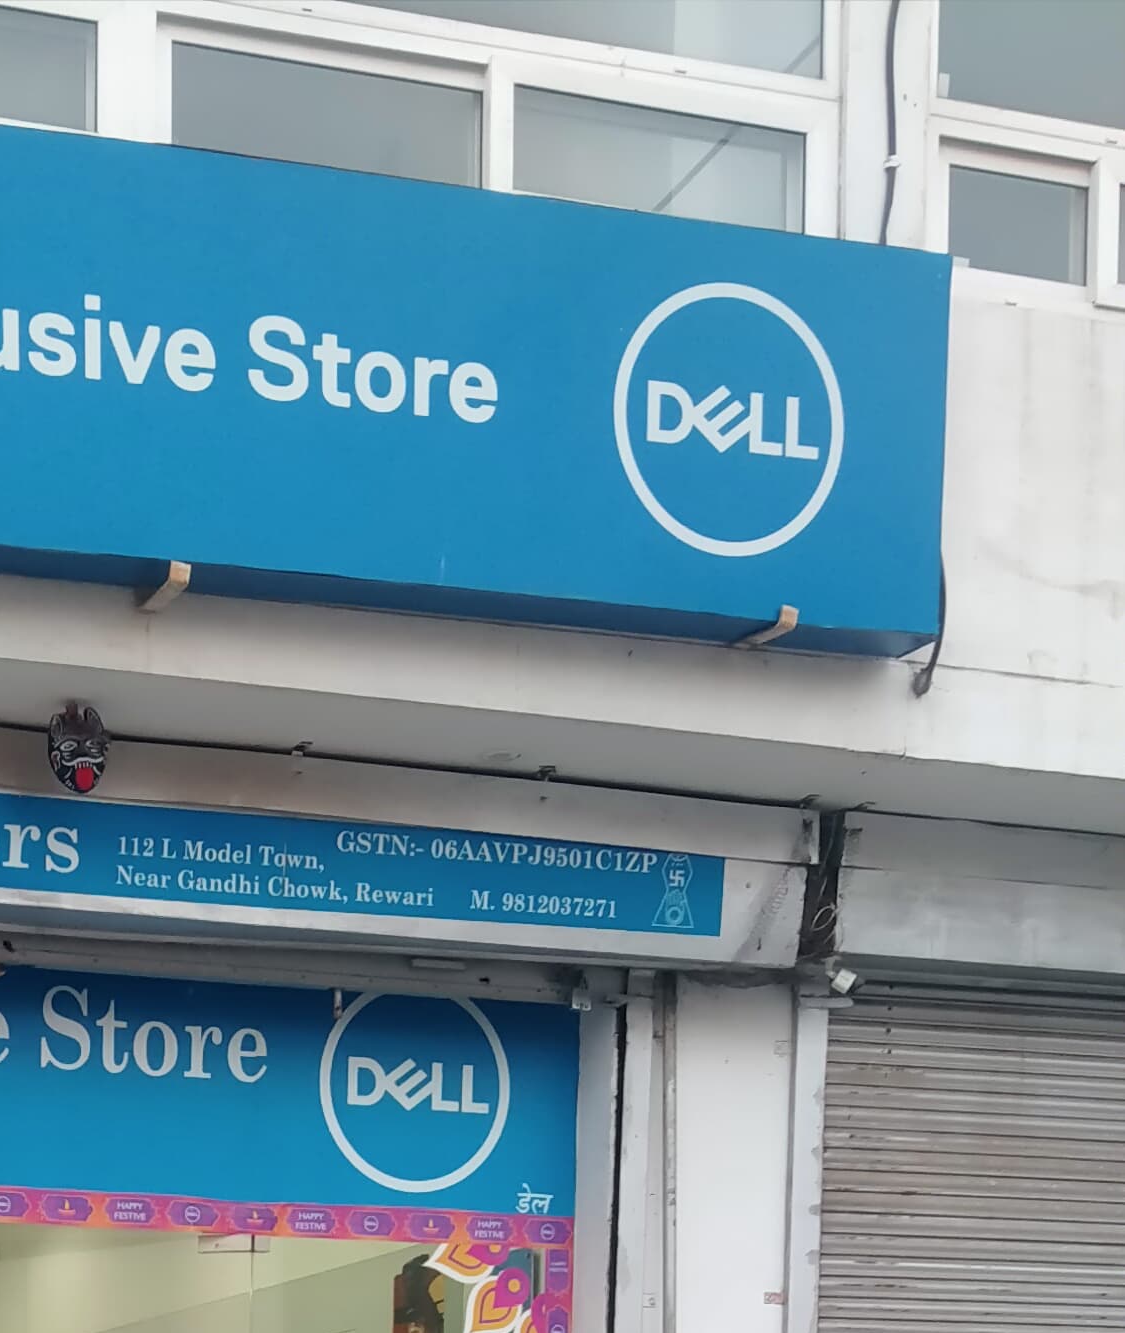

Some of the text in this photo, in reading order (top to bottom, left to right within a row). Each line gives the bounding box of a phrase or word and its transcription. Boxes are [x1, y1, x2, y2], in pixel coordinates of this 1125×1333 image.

[248, 315, 500, 424] Store
[646, 379, 820, 461] DELL
[118, 836, 325, 872] 112 L Model Town,
[431, 838, 658, 874] 06AAVPJ9501C1ZP
[116, 865, 435, 907] Near Gandhi Chowk, Rewari
[470, 890, 618, 918] M. 9812037271
[40, 984, 269, 1084] Store
[347, 1056, 490, 1115] DELL
[116, 1201, 143, 1211] HAPPY
[515, 1183, 555, 1214] डेल
[113, 1211, 146, 1221] FESTIVE
[295, 1221, 326, 1231] FESTIVE
[298, 1212, 324, 1221] HAPPY
[477, 1220, 502, 1229] HAPPY
[474, 1229, 505, 1239] FESTIVE
